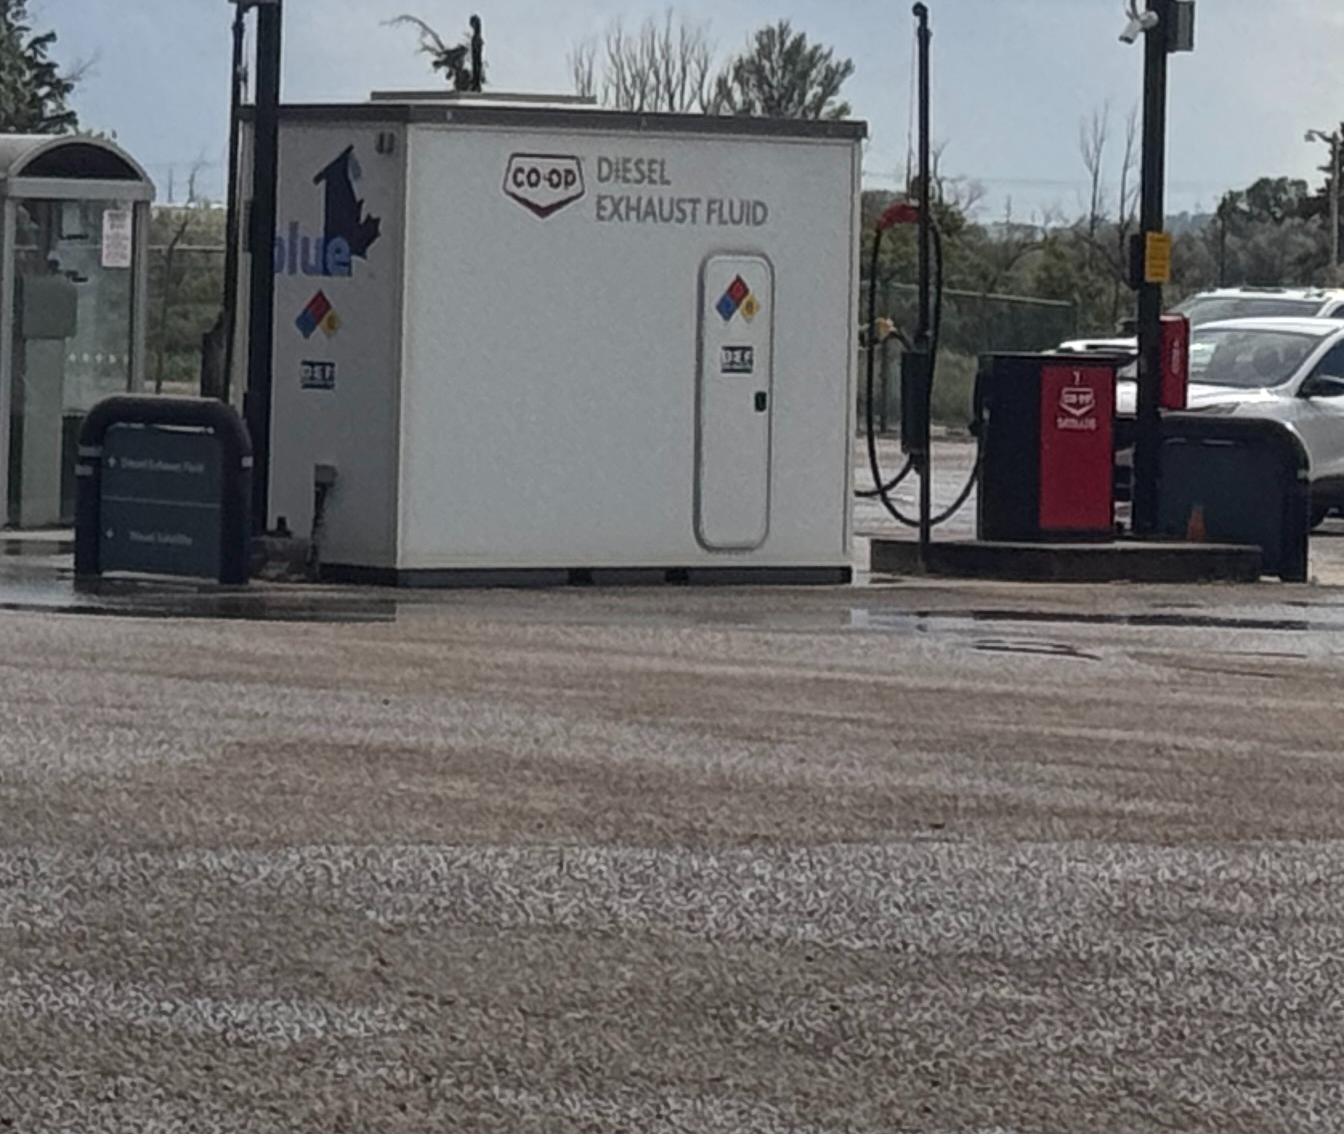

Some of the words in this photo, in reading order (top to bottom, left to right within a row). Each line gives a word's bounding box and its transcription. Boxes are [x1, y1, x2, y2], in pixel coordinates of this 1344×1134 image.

[512, 167, 577, 190] CO-OP
[597, 155, 672, 186] DIESEL
[595, 194, 701, 223] EXHAUST
[706, 197, 769, 227] FLUID
